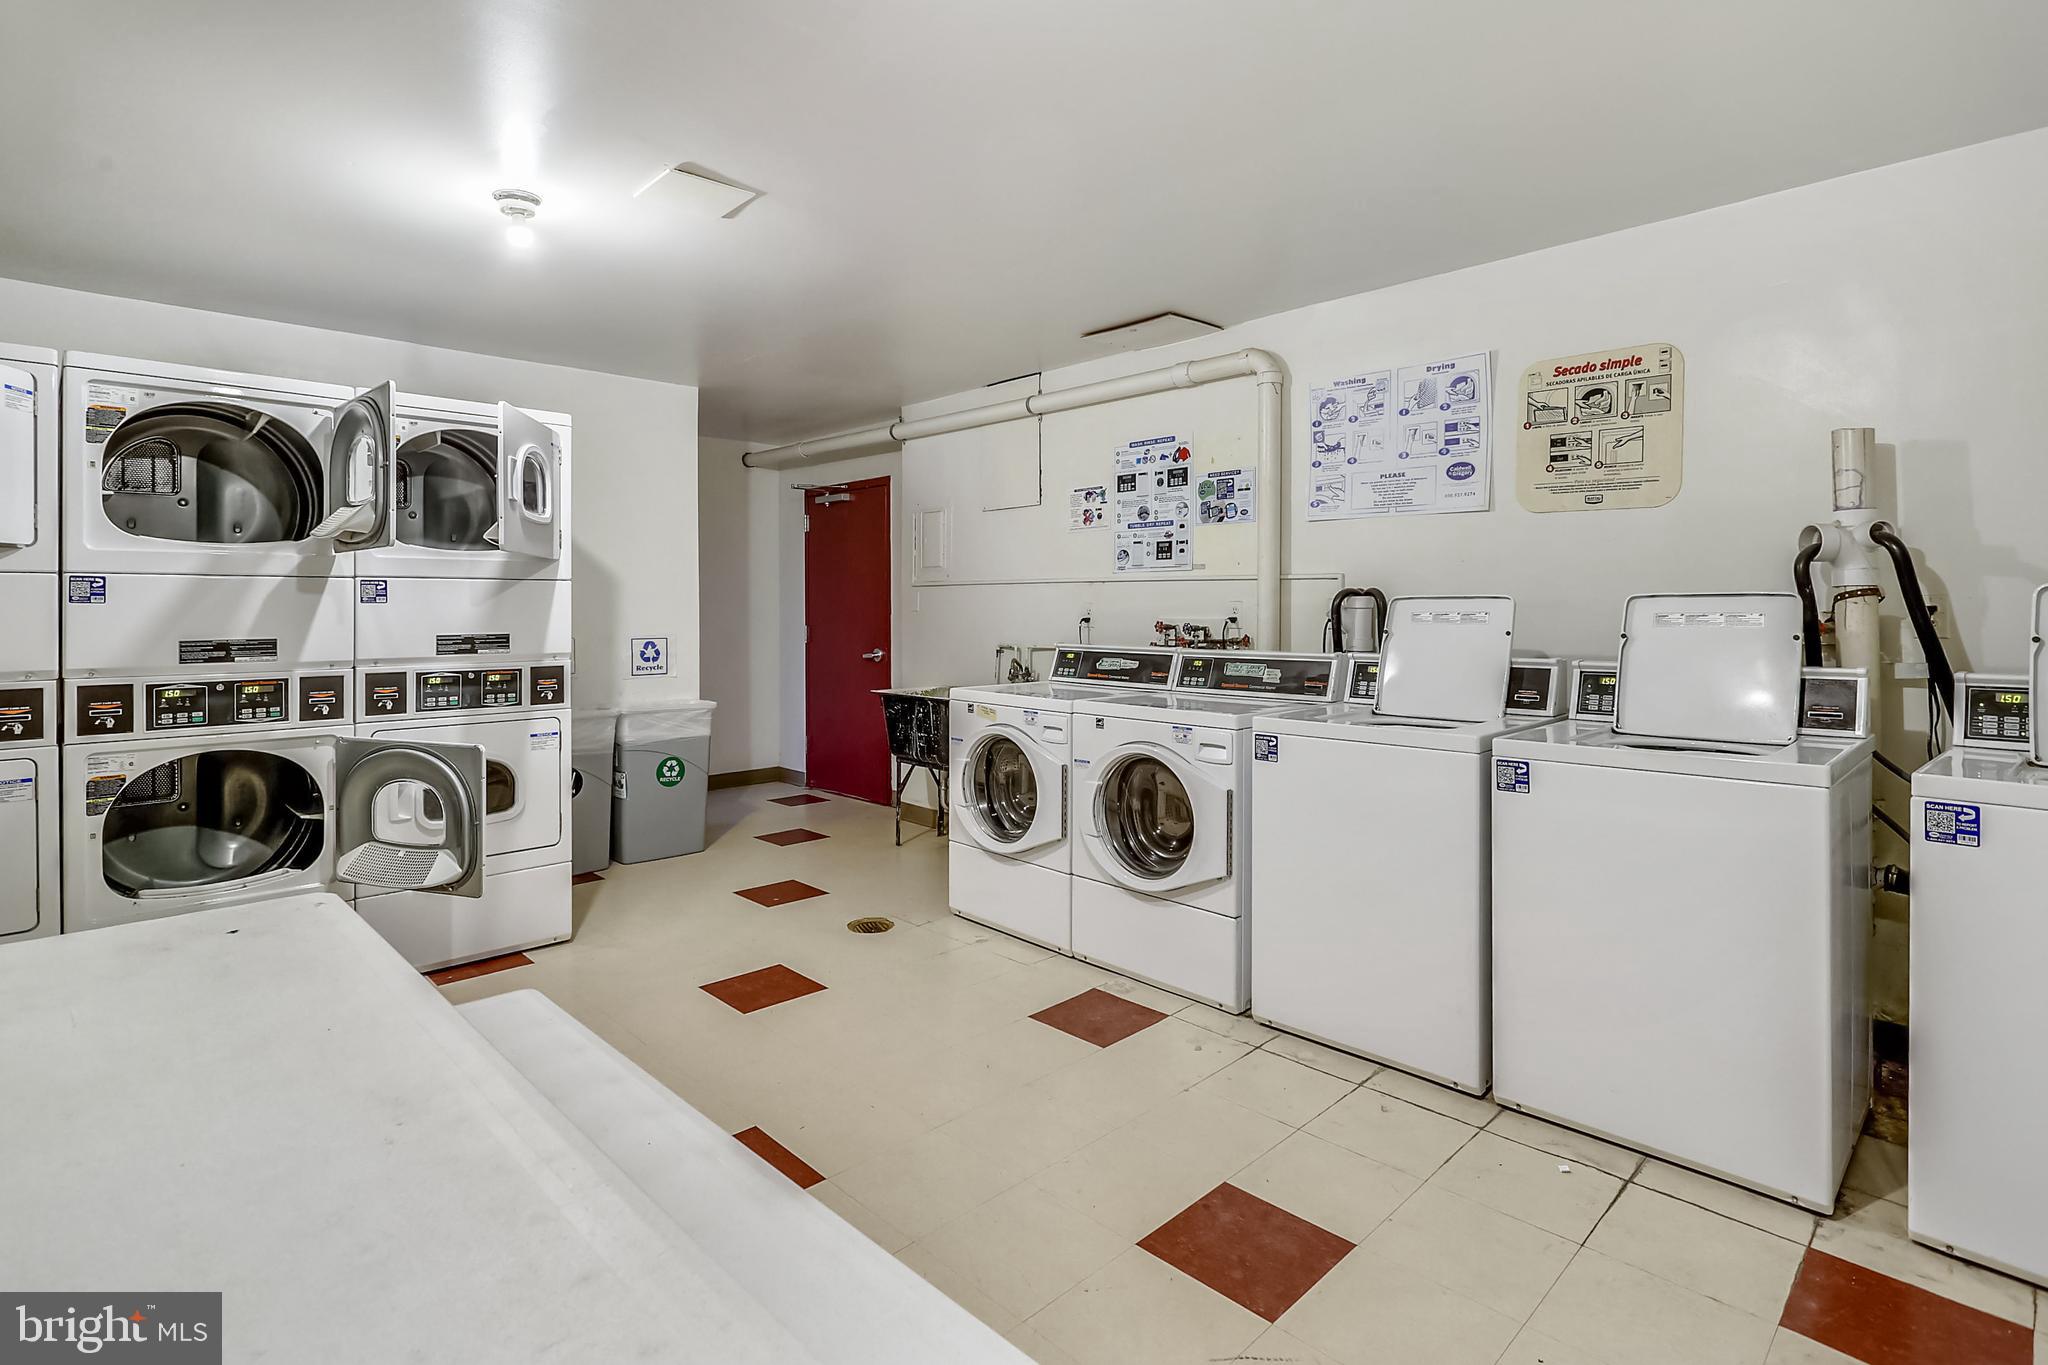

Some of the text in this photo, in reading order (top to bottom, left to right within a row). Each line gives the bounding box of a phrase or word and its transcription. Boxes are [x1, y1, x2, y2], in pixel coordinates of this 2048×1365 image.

[1426, 362, 1456, 373] Drying
[1553, 355, 1643, 377] Secado simple
[1333, 377, 1367, 388] Washing
[1545, 378, 1576, 387] SECADORAS
[1577, 374, 1604, 383] APILABLES
[1633, 368, 1651, 376] ÚNICA
[636, 664, 664, 672] Recycle
